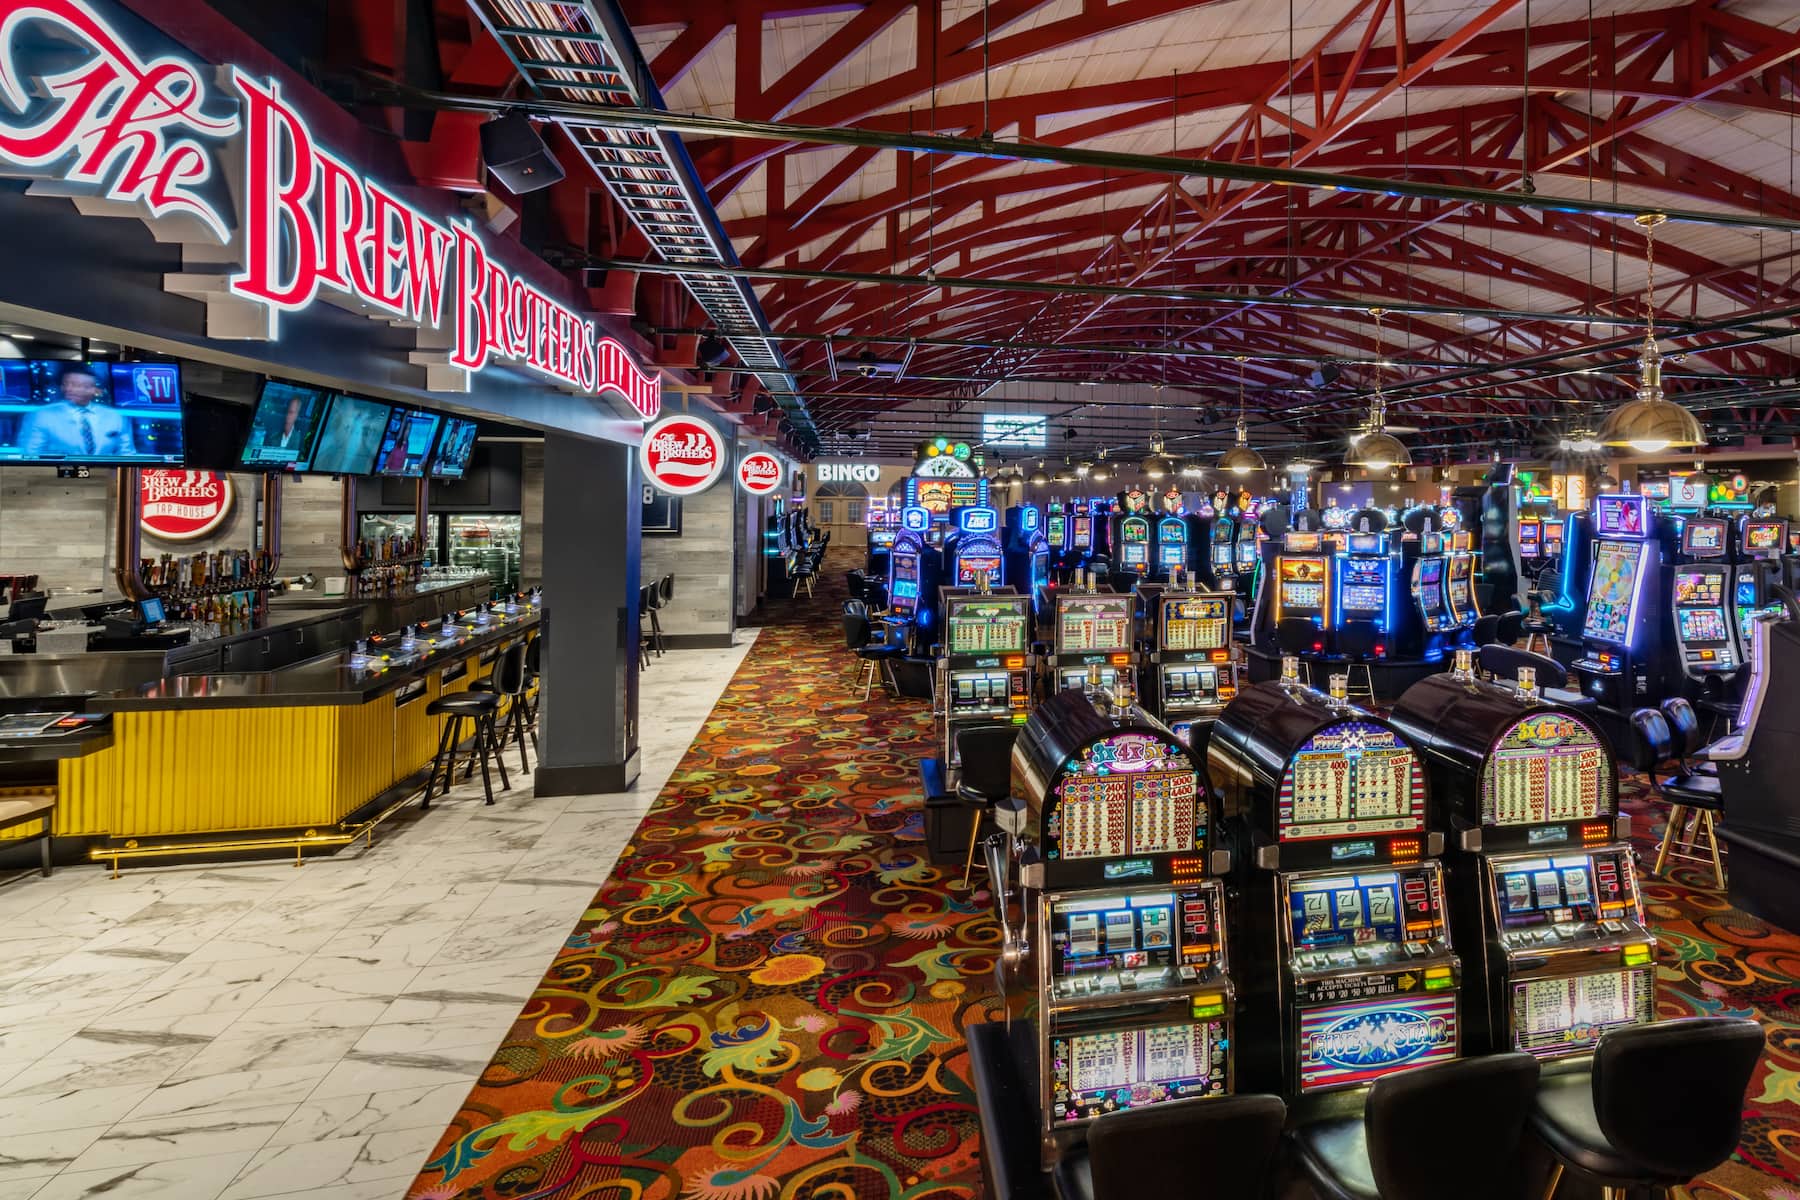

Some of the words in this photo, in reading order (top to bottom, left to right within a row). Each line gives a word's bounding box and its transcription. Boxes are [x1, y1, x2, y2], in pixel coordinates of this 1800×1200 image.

[0, 0, 241, 245] The
[450, 218, 597, 393] BROTHERS
[151, 376, 172, 398] TV
[818, 464, 880, 481] BINGO
[148, 483, 218, 502] BROTHERS
[642, 486, 654, 504] 8
[156, 504, 173, 514] TAP
[177, 506, 206, 518] HOUSE
[1377, 983, 1395, 994] BILLS
[1393, 1016, 1448, 1047] STAR
